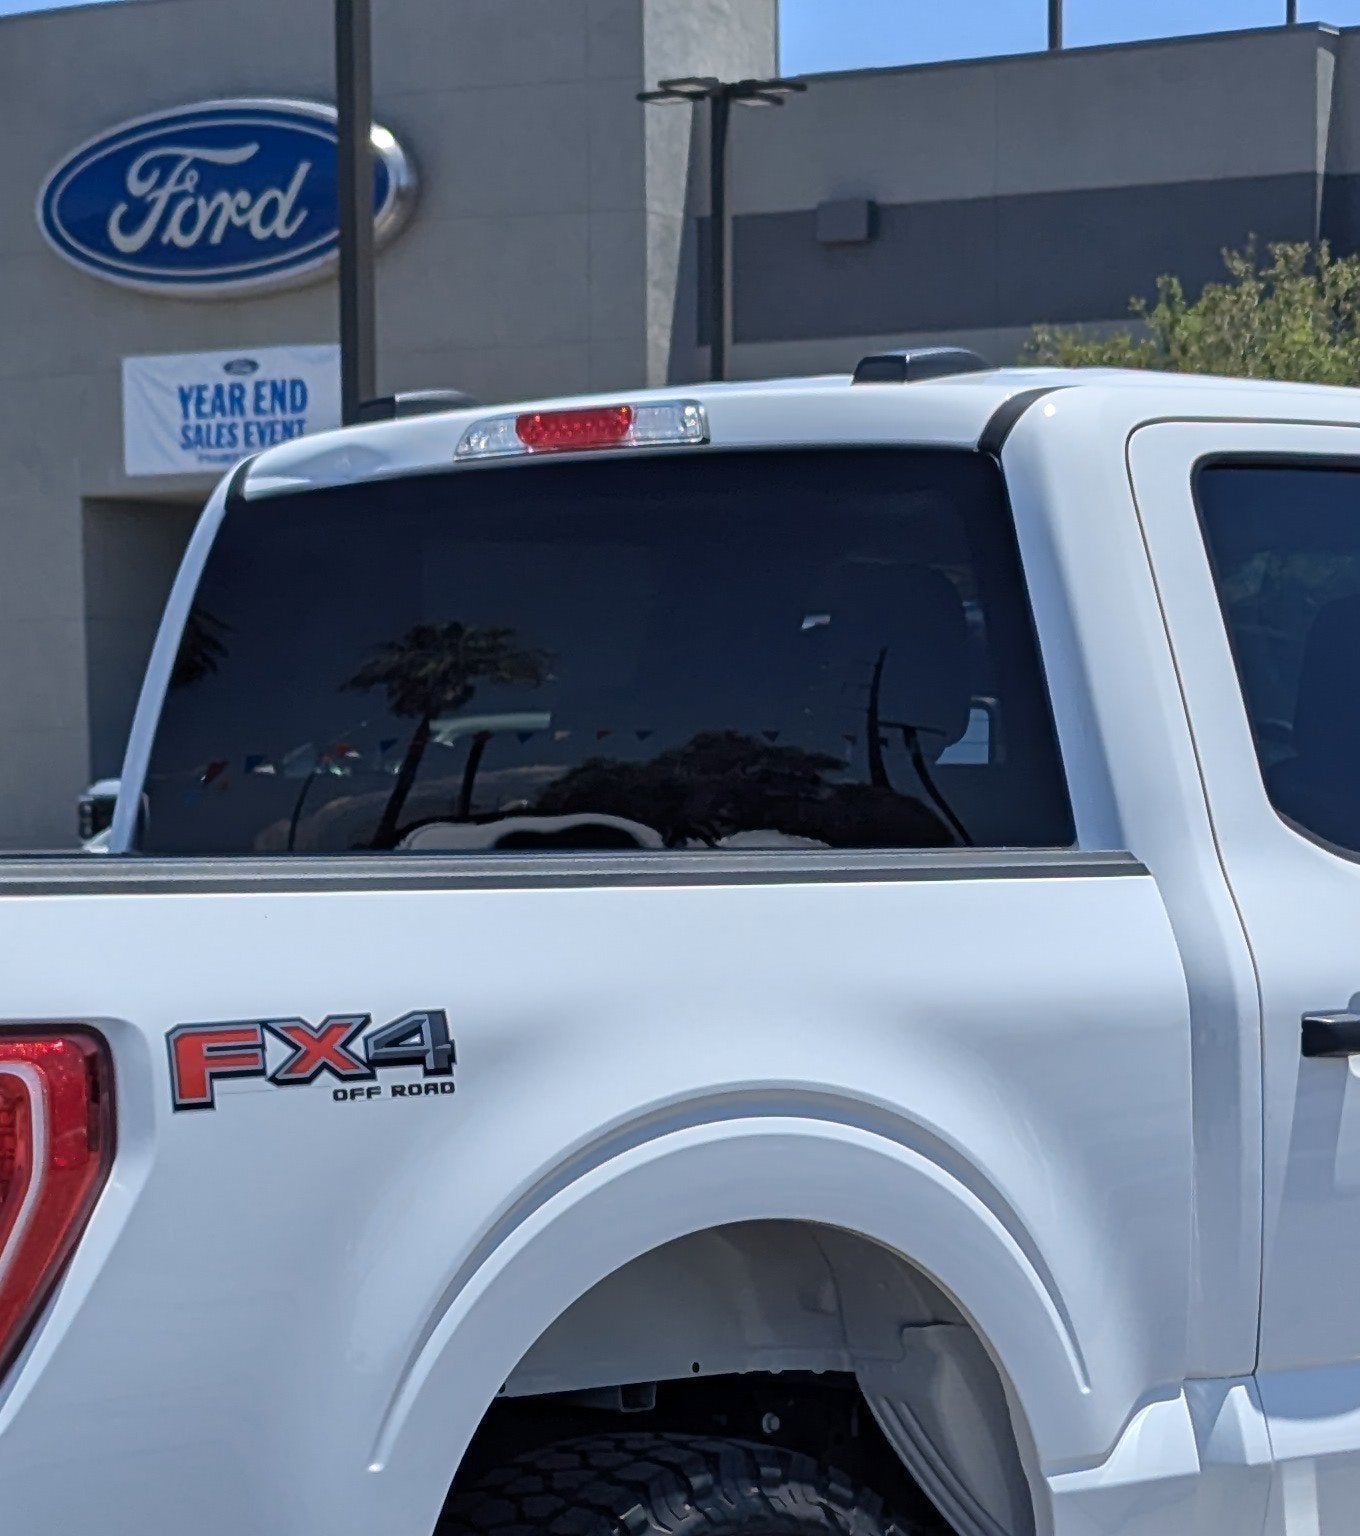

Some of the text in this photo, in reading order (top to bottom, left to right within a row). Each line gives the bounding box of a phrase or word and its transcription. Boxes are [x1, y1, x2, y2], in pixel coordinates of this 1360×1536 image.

[108, 142, 312, 253] Ford
[178, 377, 308, 420] YEAR END
[180, 419, 306, 450] SALES EVENT
[165, 1008, 457, 1113] FX4
[332, 1081, 456, 1102] OFF ROAD
